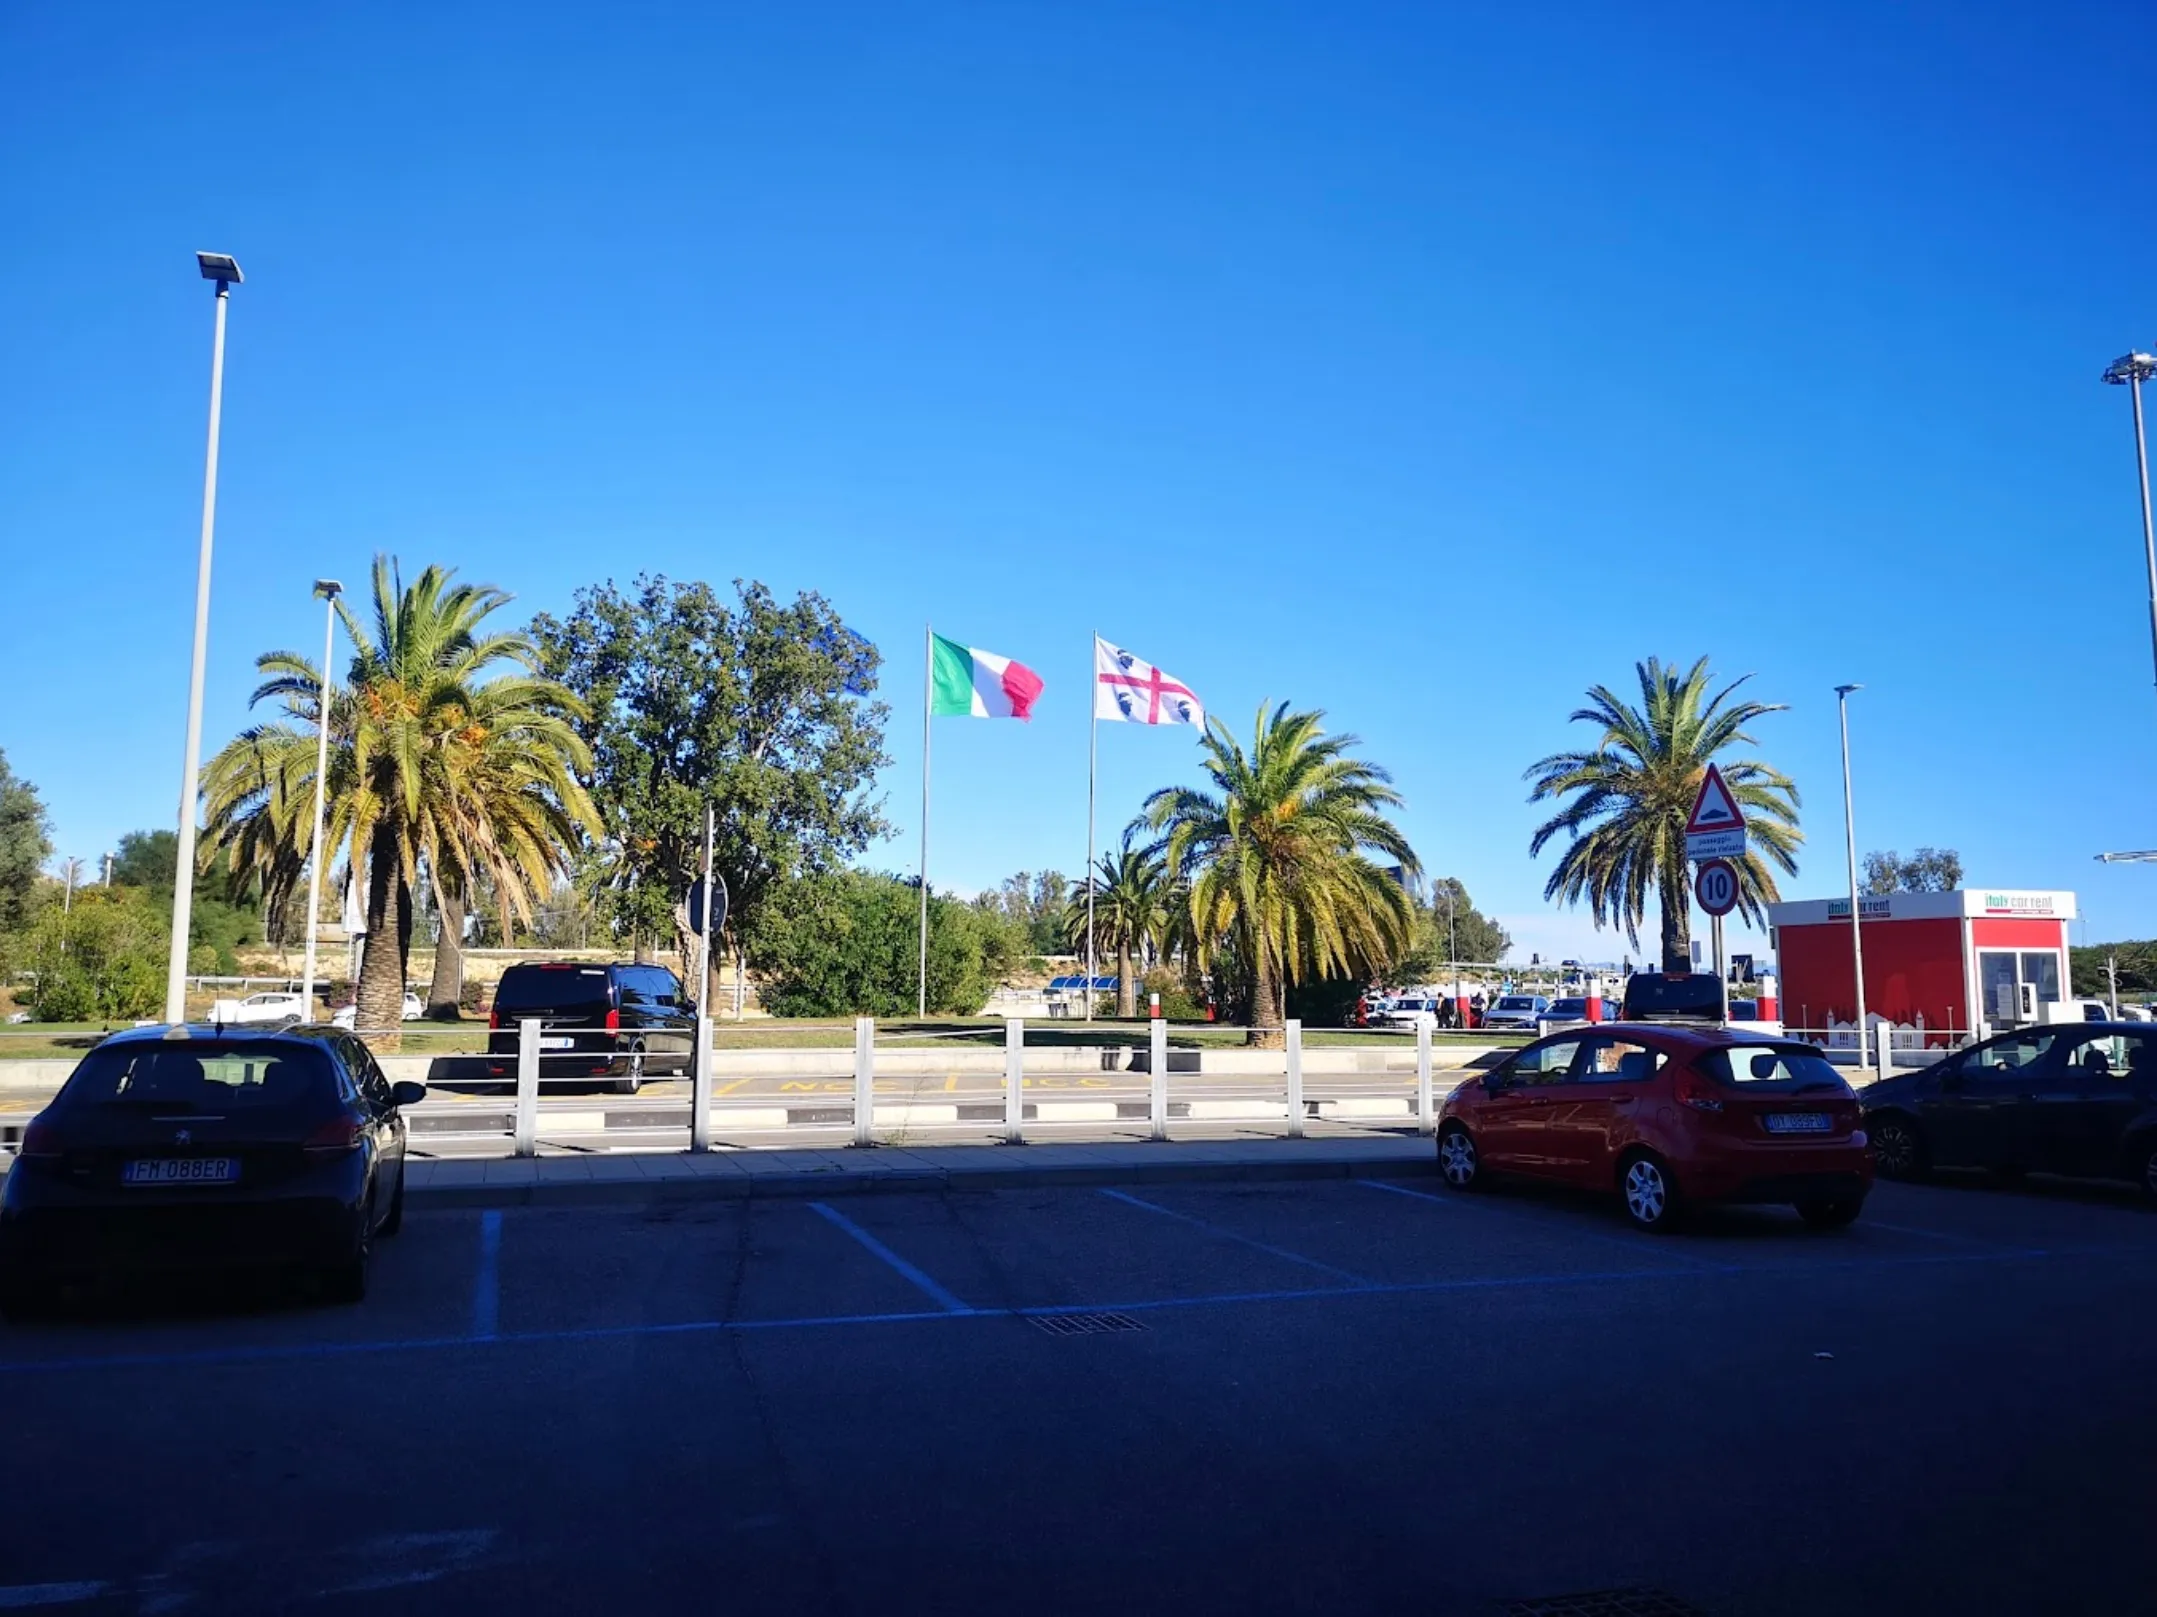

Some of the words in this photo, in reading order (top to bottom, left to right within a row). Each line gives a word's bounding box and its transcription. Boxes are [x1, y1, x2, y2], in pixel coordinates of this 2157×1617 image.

[1706, 873, 1728, 900] 10
[1868, 899, 1890, 912] rent
[1985, 893, 2009, 907] italy
[2010, 896, 2028, 907] car
[2030, 896, 2052, 908] rent
[136, 1161, 160, 1179] FM
[167, 1160, 227, 1178] 088ER
